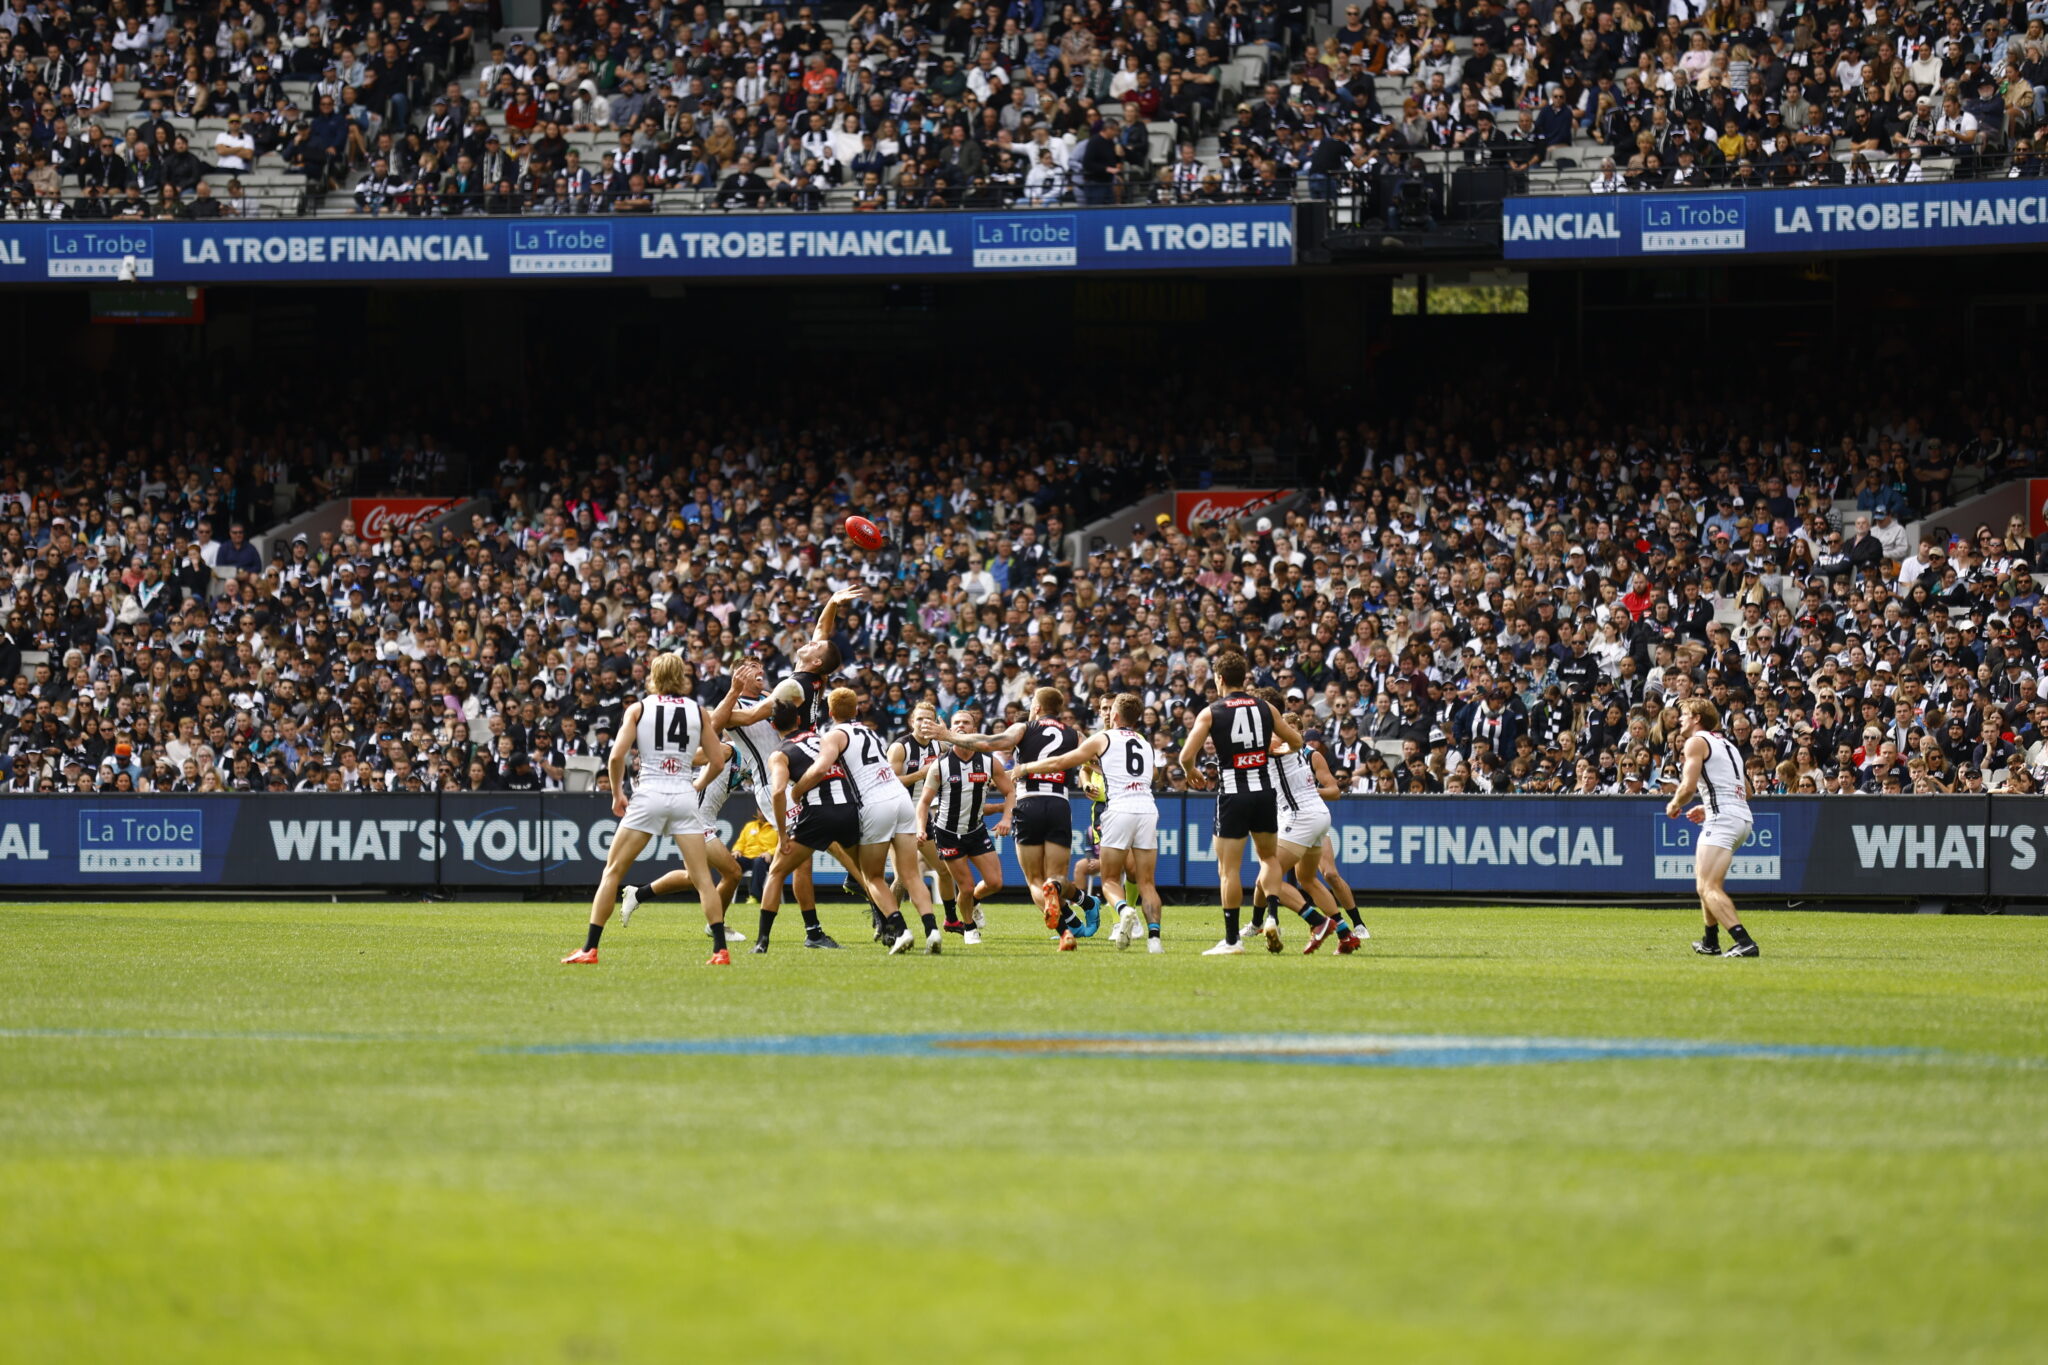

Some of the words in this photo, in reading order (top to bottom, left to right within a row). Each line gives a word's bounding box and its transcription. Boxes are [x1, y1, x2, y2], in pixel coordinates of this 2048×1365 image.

[1647, 207, 1671, 226] La
[1677, 204, 1739, 225] Trobe
[1775, 207, 1812, 233] LA
[1816, 202, 1919, 231] TROBE
[1924, 196, 2048, 228] FINANCI
[53, 235, 78, 254] La
[83, 234, 147, 254] Trobe
[515, 230, 540, 250] La
[544, 229, 606, 249] Trobe
[641, 233, 679, 259] LA
[681, 231, 785, 258] TROBE
[790, 229, 952, 257] FINANCIAL
[979, 225, 1003, 244] La
[1008, 222, 1070, 243] Trobe
[1105, 225, 1142, 251] LA
[1145, 223, 1247, 250] TROBE
[1252, 221, 1292, 247] FIN
[1648, 234, 1739, 247] financial
[183, 238, 220, 264] LA
[223, 237, 326, 263] TROBE
[330, 235, 489, 262] FINANCIAL
[980, 251, 1072, 264] financial
[54, 262, 148, 273] financl
[515, 257, 607, 270] financial
[655, 706, 690, 752] 14
[1231, 706, 1263, 749] 41
[1037, 726, 1063, 762] 2
[1126, 738, 1144, 777] 6
[1237, 753, 1266, 767] KFC
[1723, 741, 1740, 780] 1
[87, 818, 114, 842] La
[121, 818, 194, 843] Trobe
[269, 819, 446, 862] WHAT'S
[453, 819, 582, 862] YOUR
[1662, 822, 1690, 847] La
[1400, 825, 1623, 866] FINANCIAL
[1852, 824, 2037, 870] WHAT'S
[87, 853, 195, 867] financial
[1662, 860, 1774, 874] fincial
